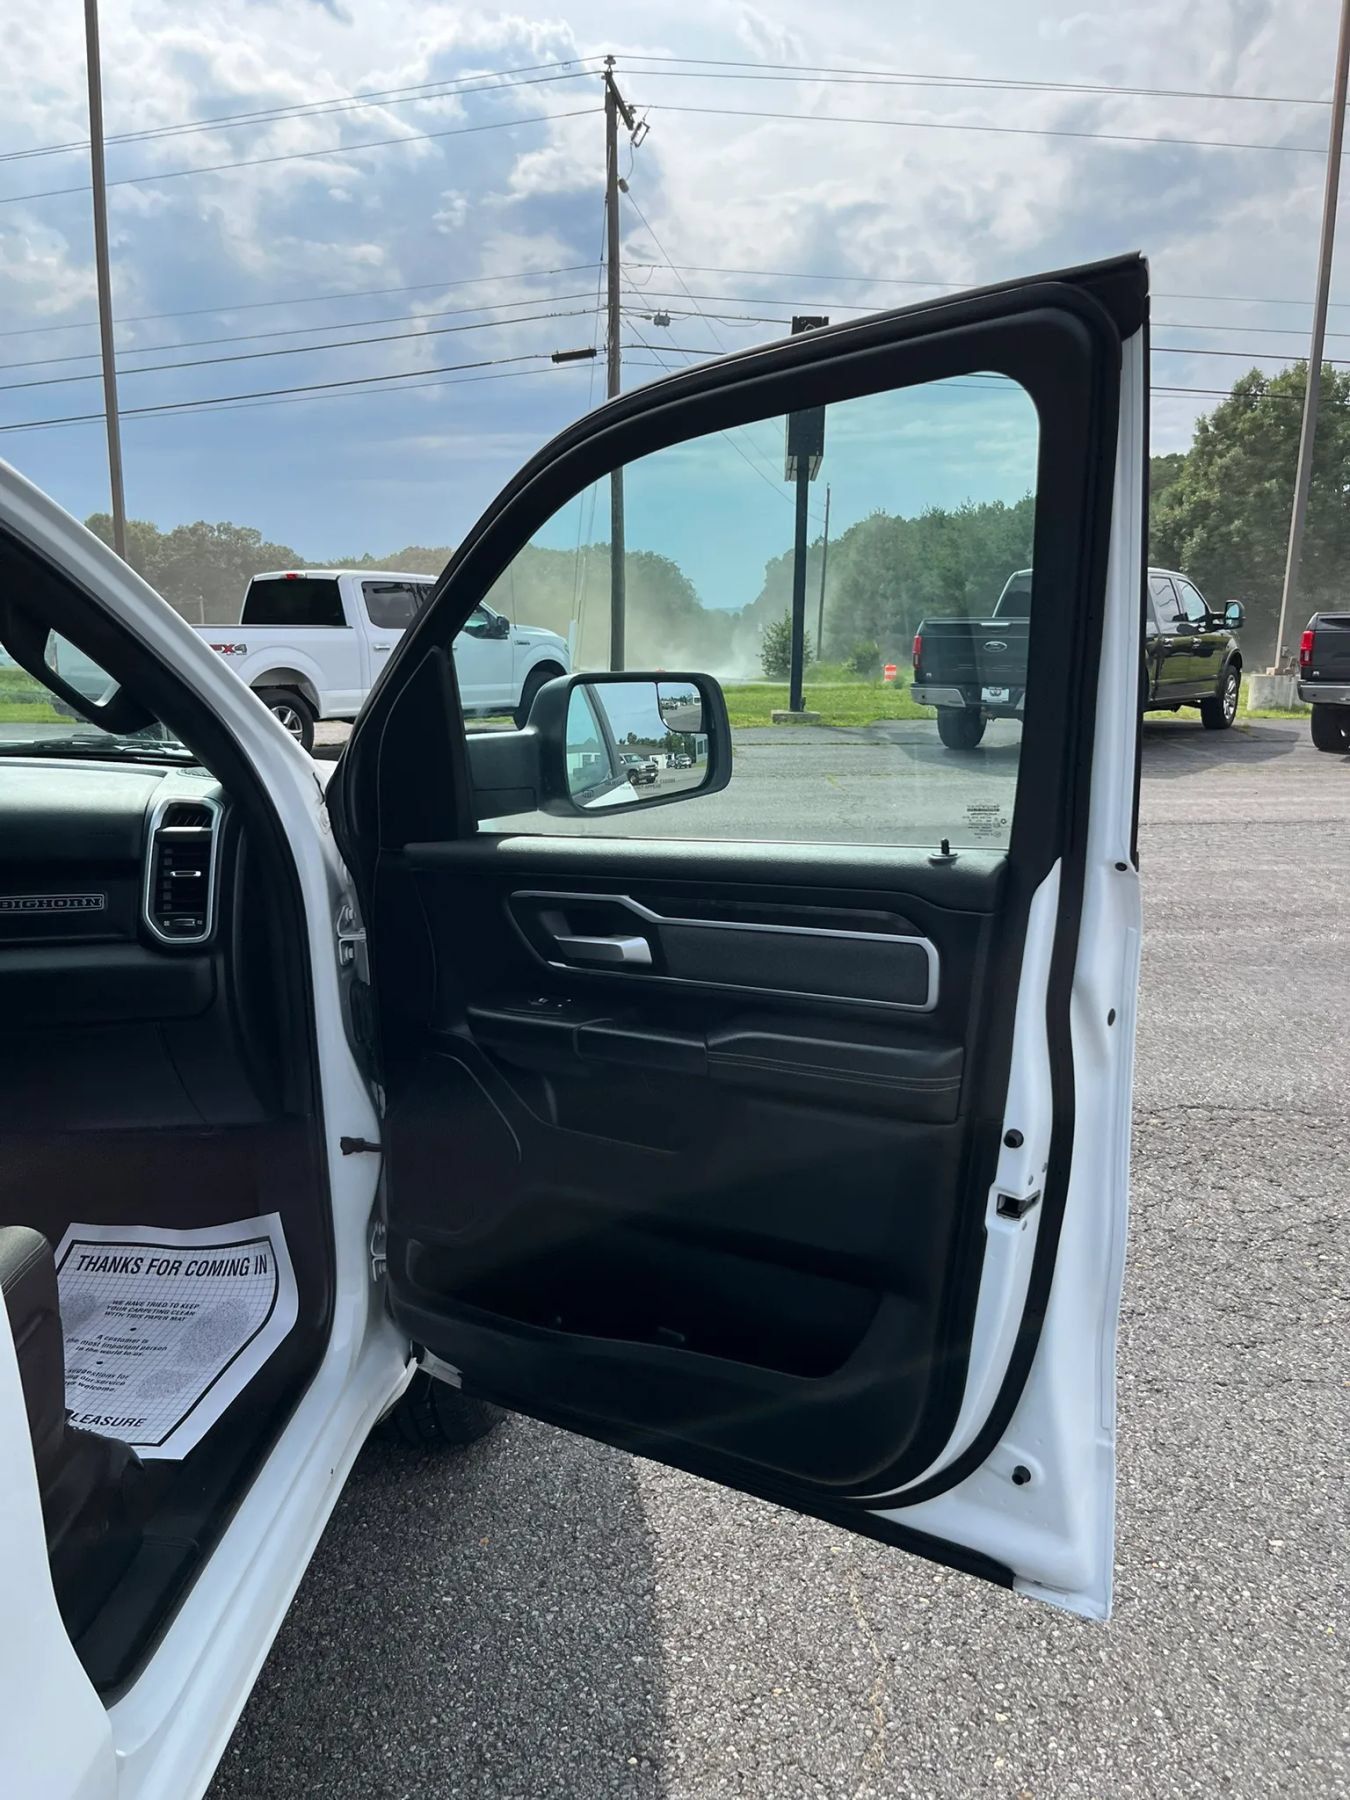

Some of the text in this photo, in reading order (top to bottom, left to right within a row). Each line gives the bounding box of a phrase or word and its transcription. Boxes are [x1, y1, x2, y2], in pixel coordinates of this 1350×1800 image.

[0, 896, 101, 909] BIGHORN
[76, 1254, 268, 1277] THANKS FOR COMING IN
[128, 1307, 170, 1315] CARPETING
[104, 1335, 140, 1344] customer
[101, 1342, 139, 1350] important
